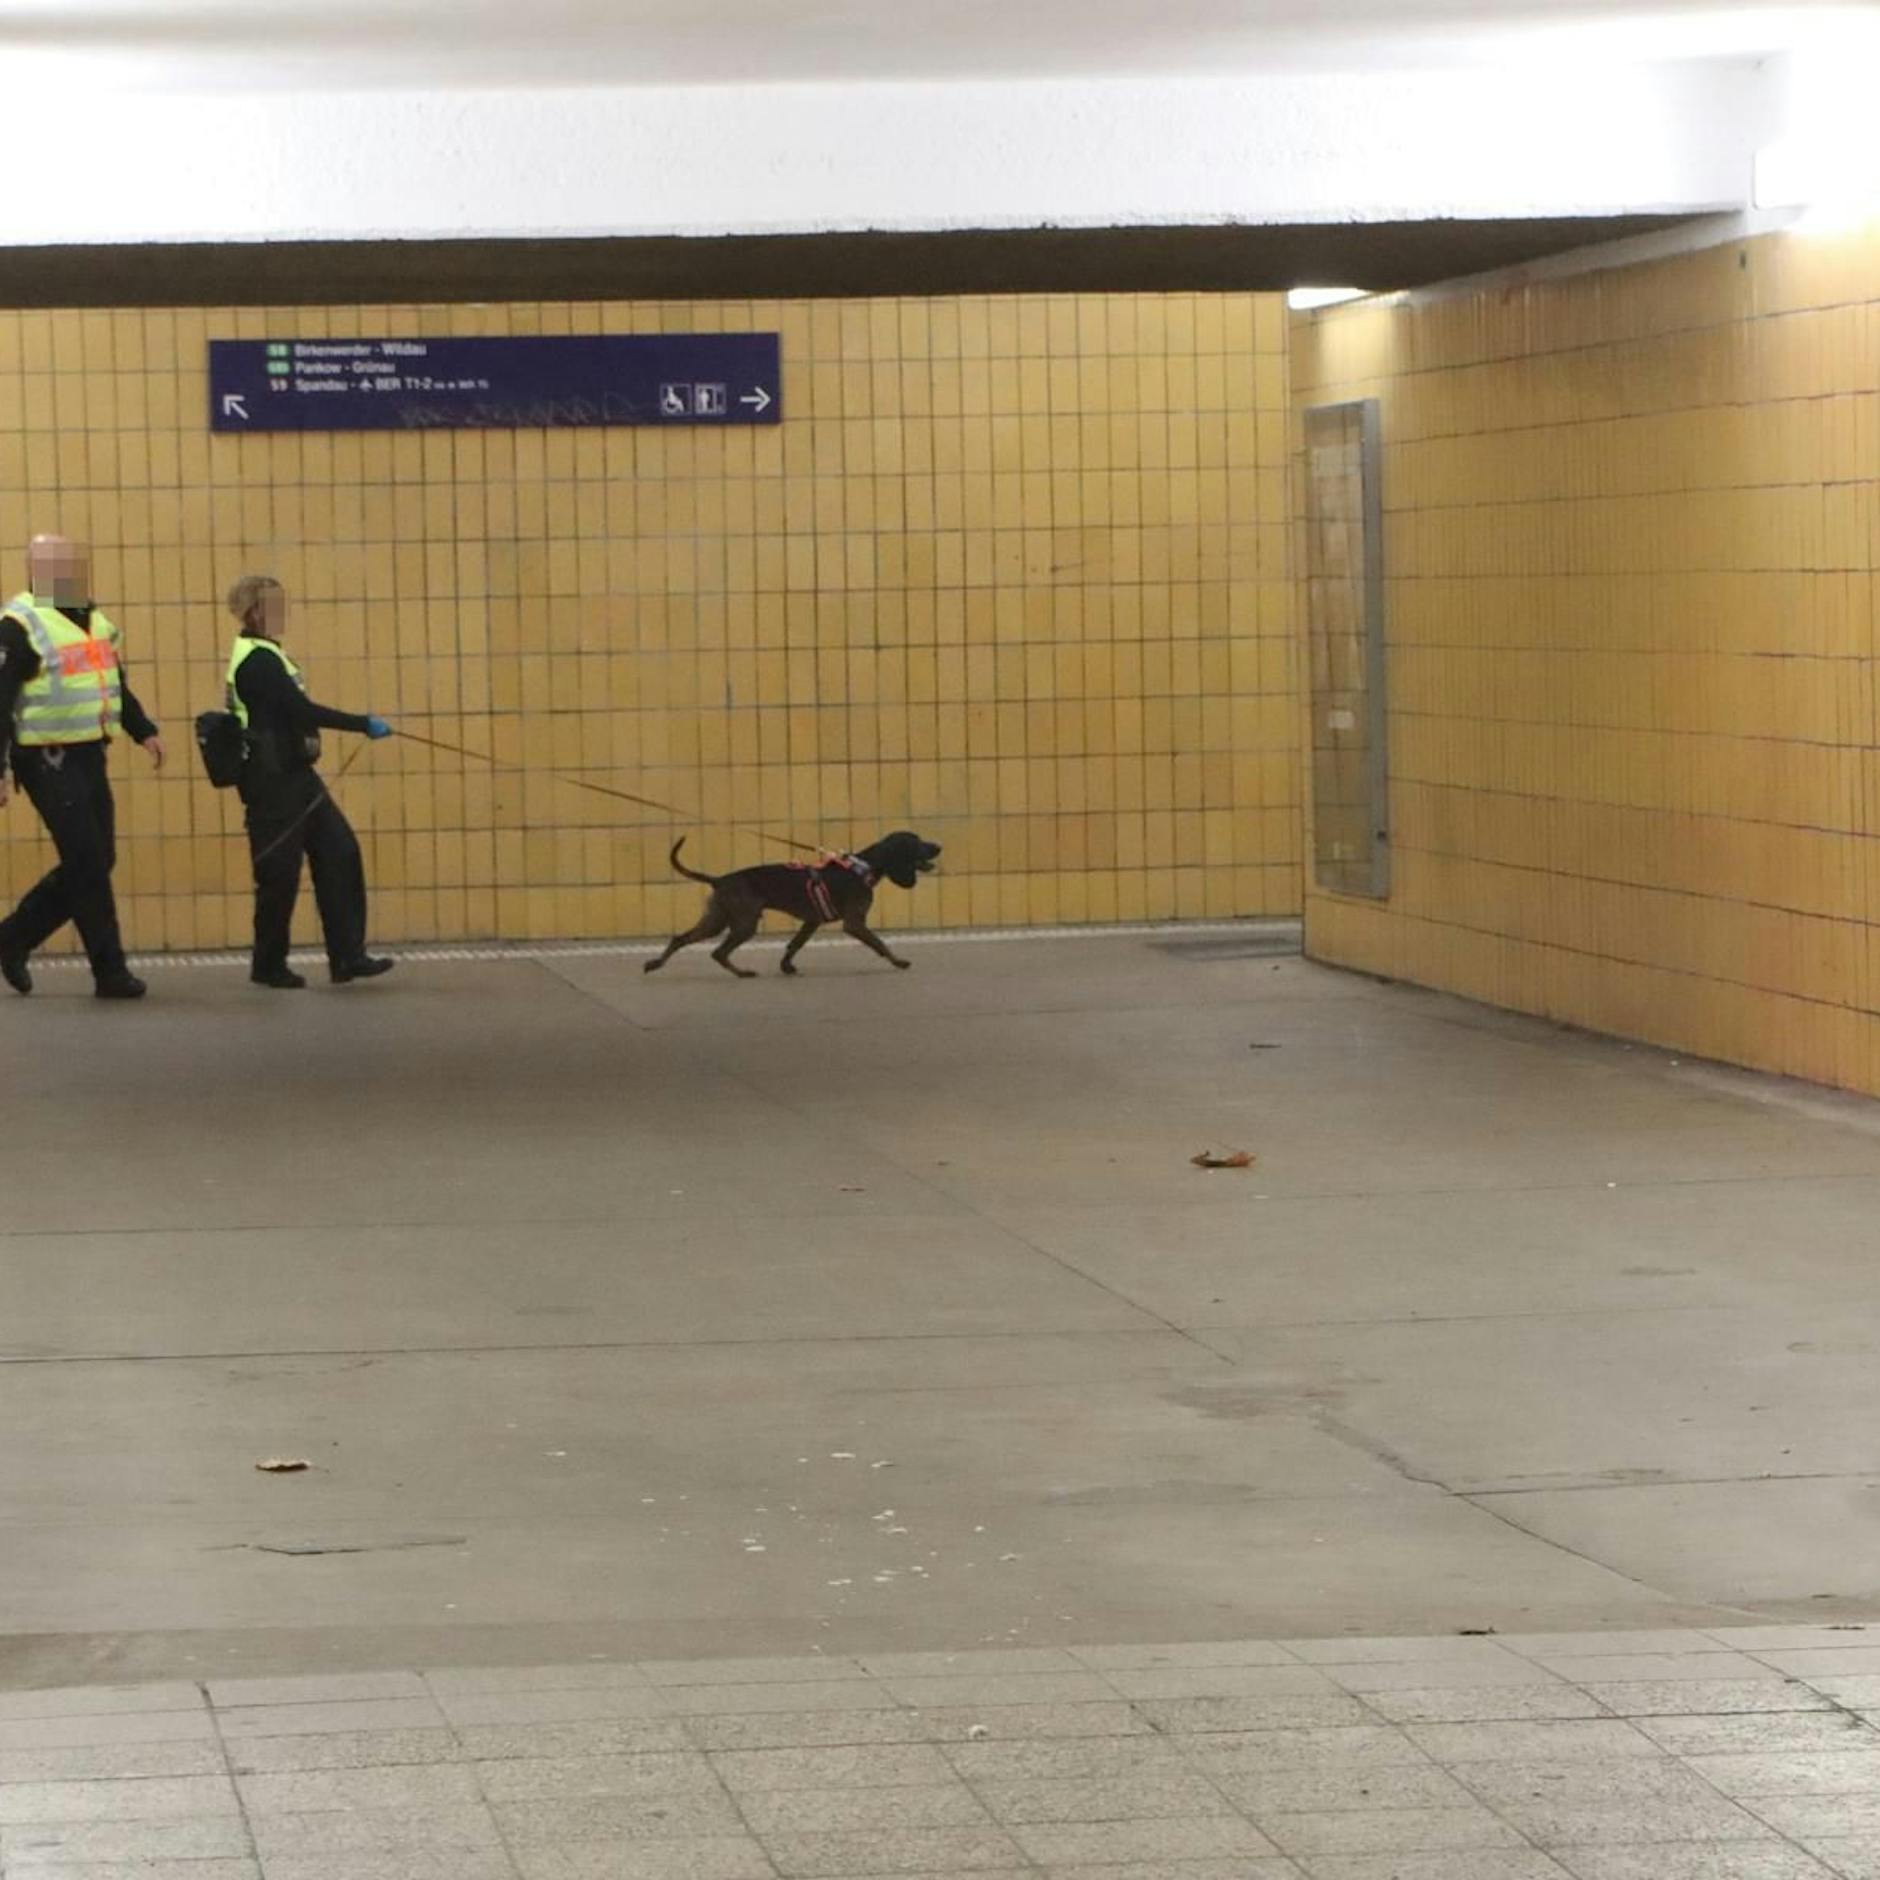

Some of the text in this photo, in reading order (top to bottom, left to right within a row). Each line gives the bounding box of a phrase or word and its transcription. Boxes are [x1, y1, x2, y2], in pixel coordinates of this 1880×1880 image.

[381, 342, 427, 356] Wildau
[294, 361, 341, 374] Pankow
[295, 378, 349, 394] Spandau
[375, 377, 401, 391] BER
[405, 376, 432, 390] T1-2
